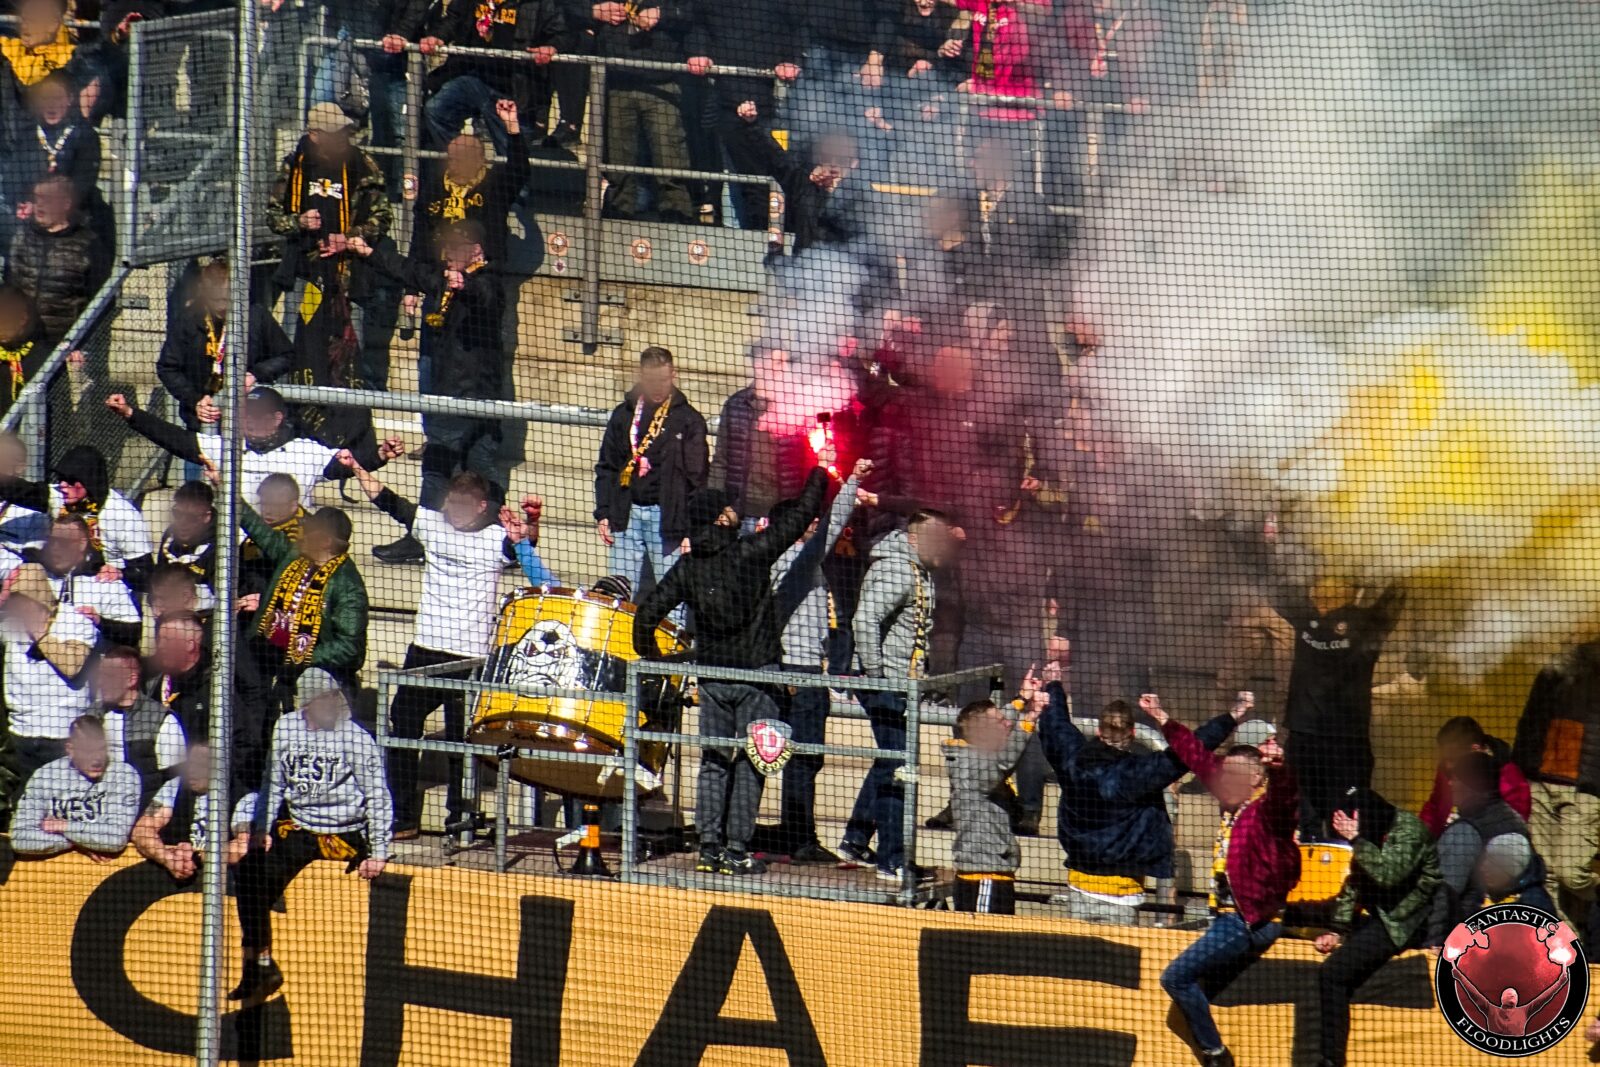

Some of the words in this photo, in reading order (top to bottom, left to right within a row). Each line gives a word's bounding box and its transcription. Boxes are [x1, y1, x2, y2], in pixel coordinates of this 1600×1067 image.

[301, 588, 321, 626] 1953
[281, 751, 341, 784] WEST
[748, 746, 793, 771] DRESDEN
[51, 791, 107, 823] WEST
